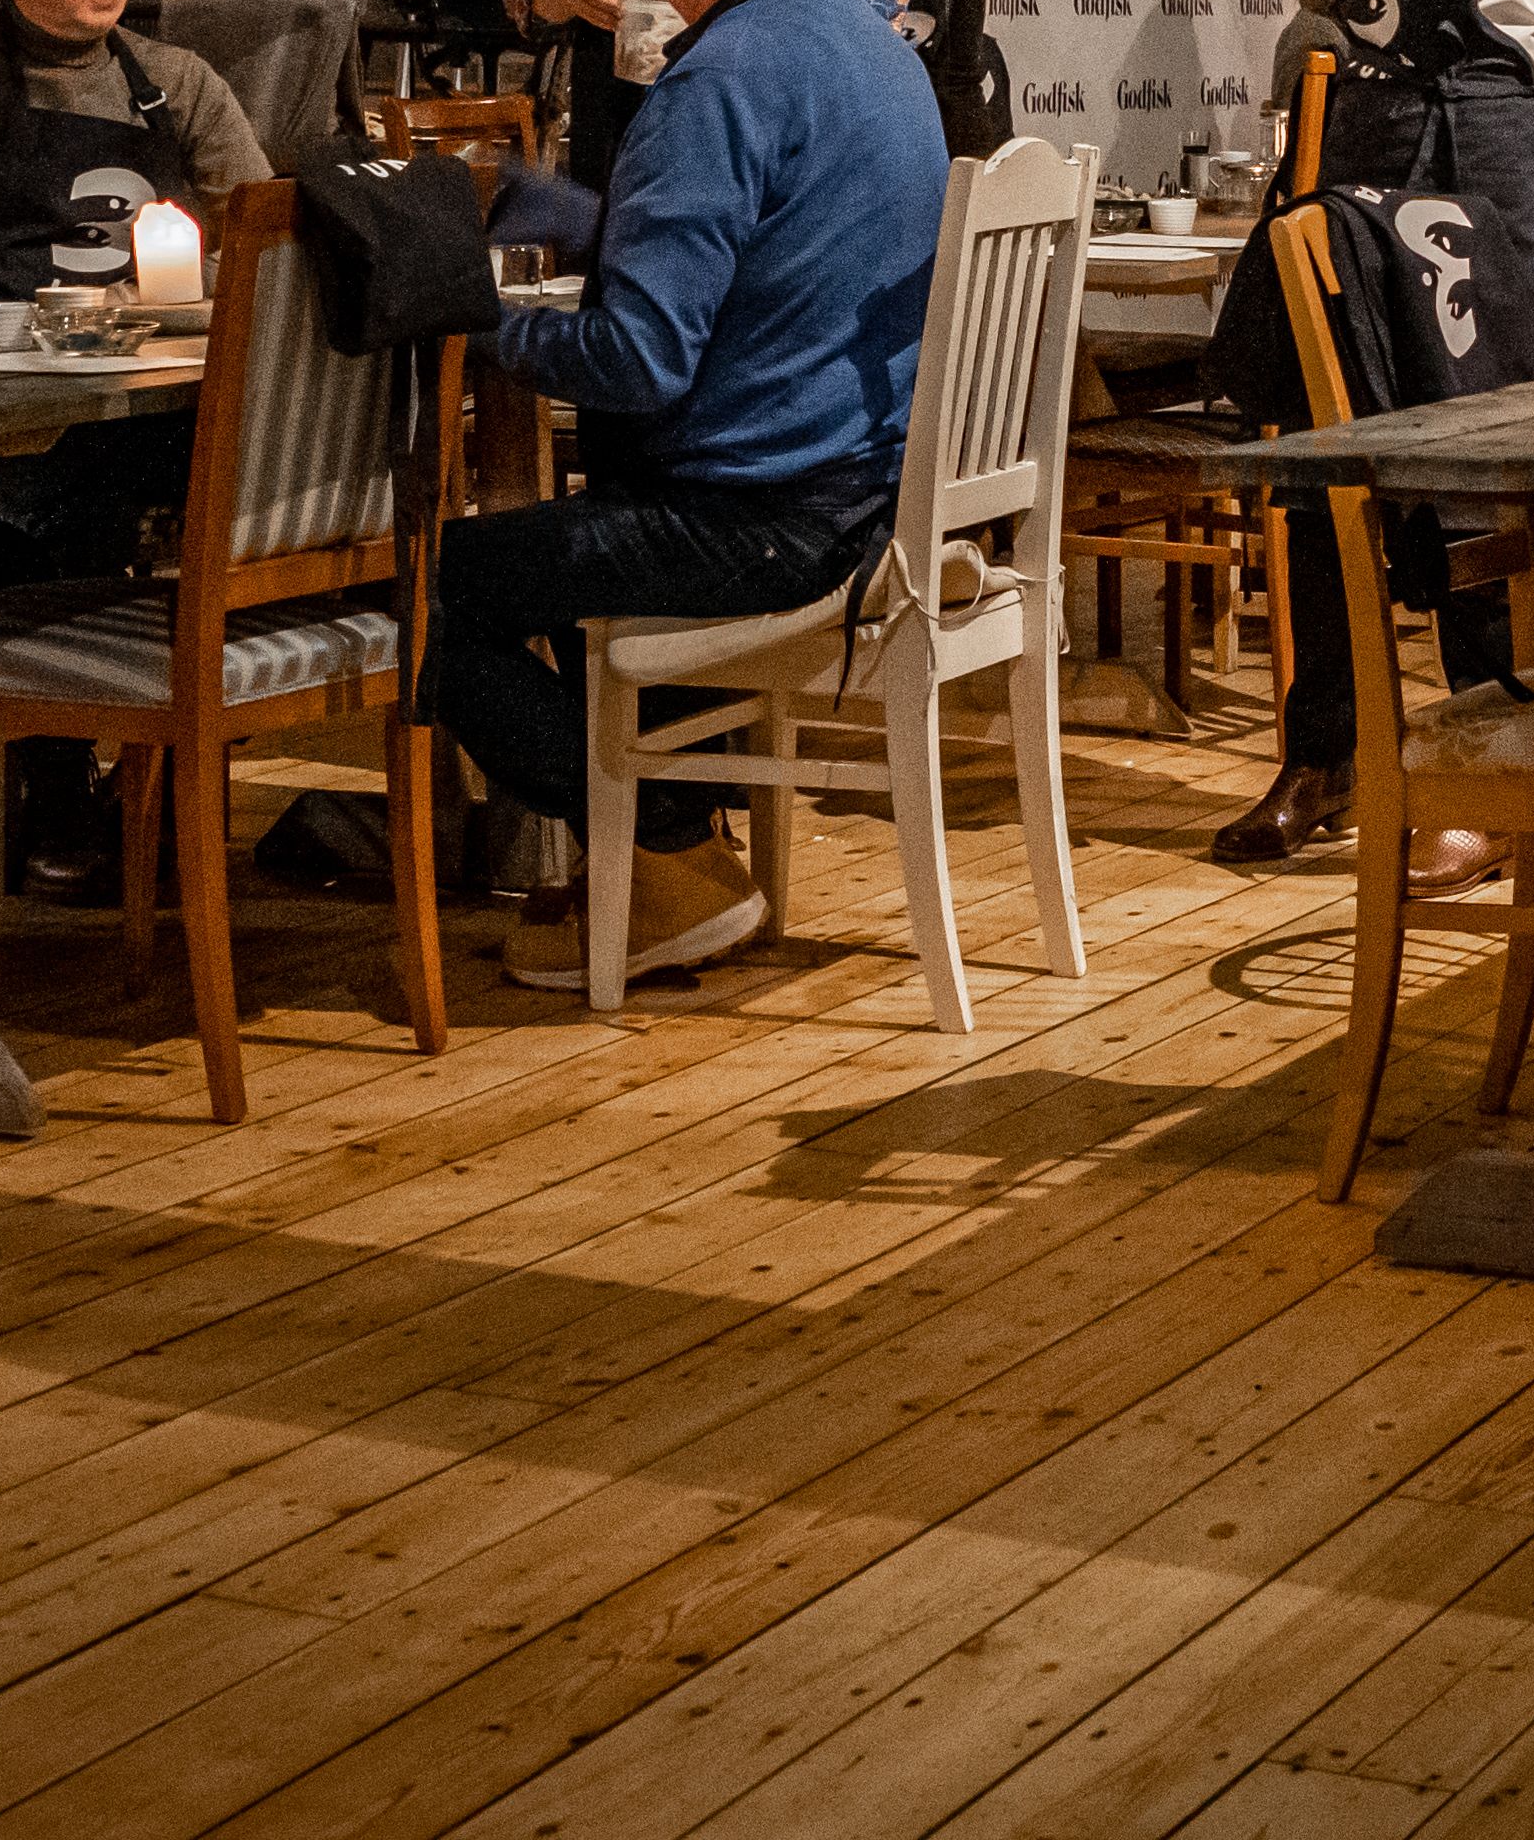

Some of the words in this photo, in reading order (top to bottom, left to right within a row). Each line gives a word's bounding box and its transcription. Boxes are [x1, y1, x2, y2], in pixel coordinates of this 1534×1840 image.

[1022, 81, 1086, 119] Godfisk
[1116, 79, 1173, 113] Godfisk
[1200, 75, 1249, 110] Godfisk
